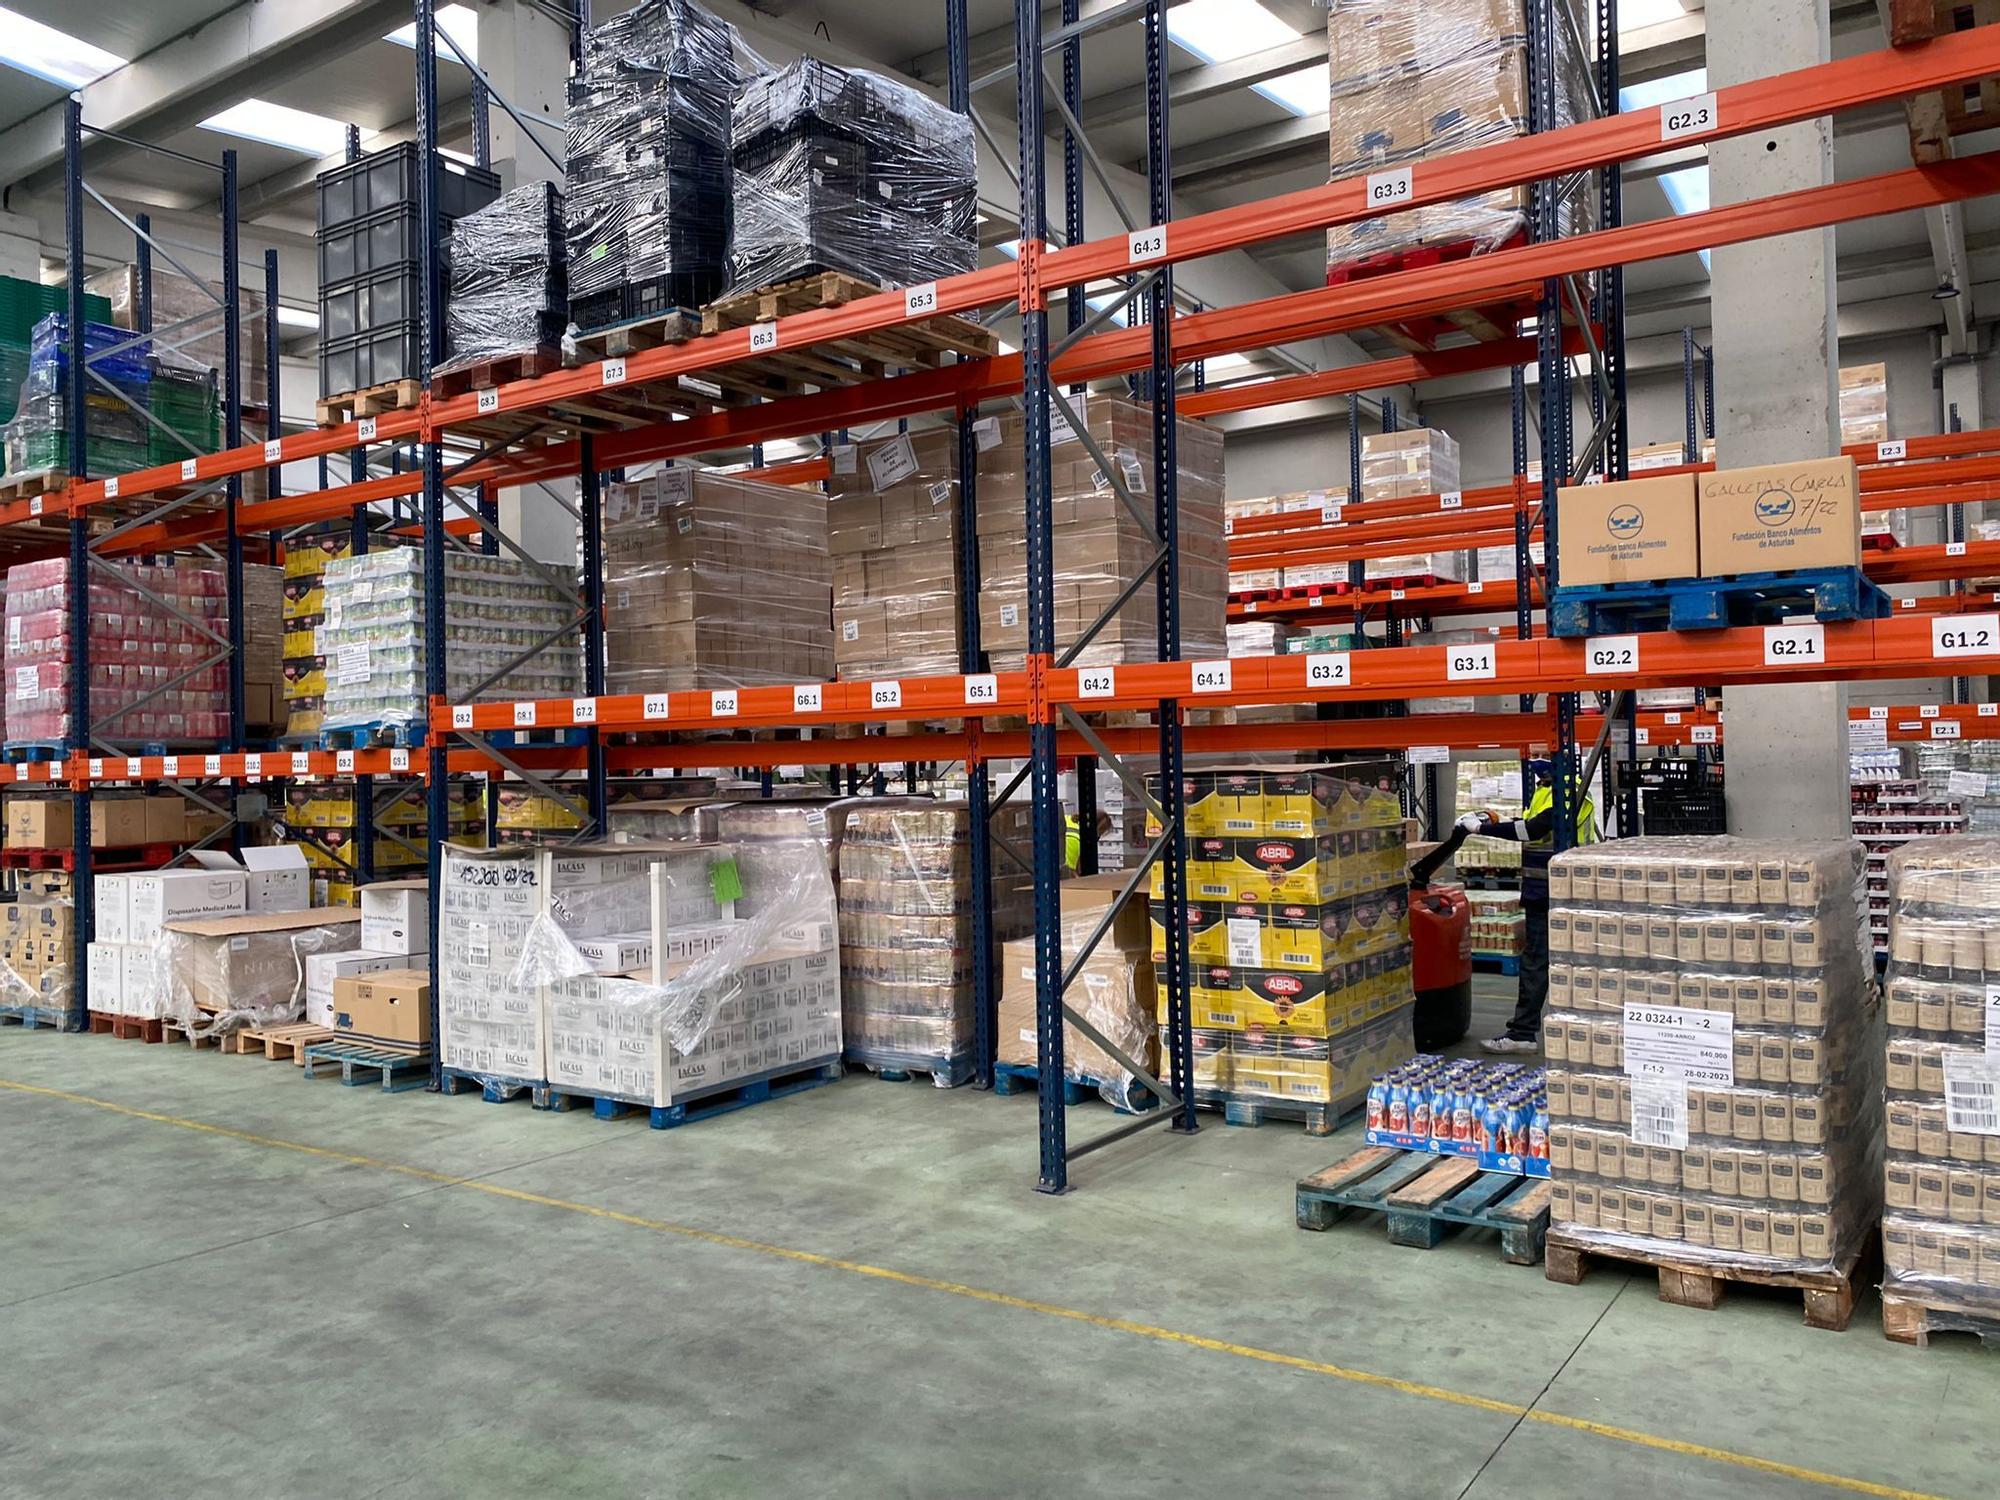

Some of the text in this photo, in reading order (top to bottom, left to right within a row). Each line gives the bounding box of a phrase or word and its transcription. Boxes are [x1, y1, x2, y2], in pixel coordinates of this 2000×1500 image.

[1668, 109, 1711, 130] G2.3
[1373, 180, 1407, 200] G3.3
[1134, 238, 1161, 255] G4.3
[910, 293, 932, 308] G5.3
[753, 332, 772, 346] G6.3
[606, 367, 623, 379] G7.3
[481, 396, 495, 407] G8.3
[361, 425, 374, 435] G9.3
[1882, 446, 1902, 456] E2.3
[1705, 479, 1786, 499] GALLETAS
[1800, 493, 1839, 528] 7/22
[1766, 528, 1788, 539] Banco
[1788, 526, 1822, 537] Alimentos
[1759, 538, 1796, 549] de Asturias
[1941, 631, 1989, 648] G1.2
[1772, 639, 1815, 655] G2.1
[1455, 656, 1489, 671] G3.1
[1594, 650, 1631, 665] G2.2
[1312, 665, 1343, 679] G3.2
[1084, 678, 1109, 690] G4.2
[1197, 673, 1225, 686] G4.1
[875, 691, 896, 702] G5.2
[970, 686, 992, 697] G5.1
[715, 700, 734, 711] G6.2
[798, 695, 817, 705] G6.1
[576, 707, 592, 717] G7.2
[647, 703, 664, 713] G7.1
[1935, 727, 1956, 735] E2.1
[247, 761, 260, 770] G10.2
[339, 758, 351, 767] G9.2
[393, 756, 406, 766] G9.1
[1260, 847, 1292, 859] ABRIL
[557, 862, 586, 874] LACASA
[167, 903, 242, 916] Disposable Medical Mask
[579, 946, 603, 960] LACASA
[805, 956, 828, 969] LACASA
[1269, 979, 1300, 991] ABRIL
[1628, 1011, 1642, 1022] 22
[1645, 1012, 1683, 1026] 0324-1
[1703, 1019, 1711, 1029] 2
[559, 1061, 584, 1076] LACASA
[678, 1063, 707, 1080] LACASA
[1643, 1063, 1730, 1082] F-1-2 28-02-2023
